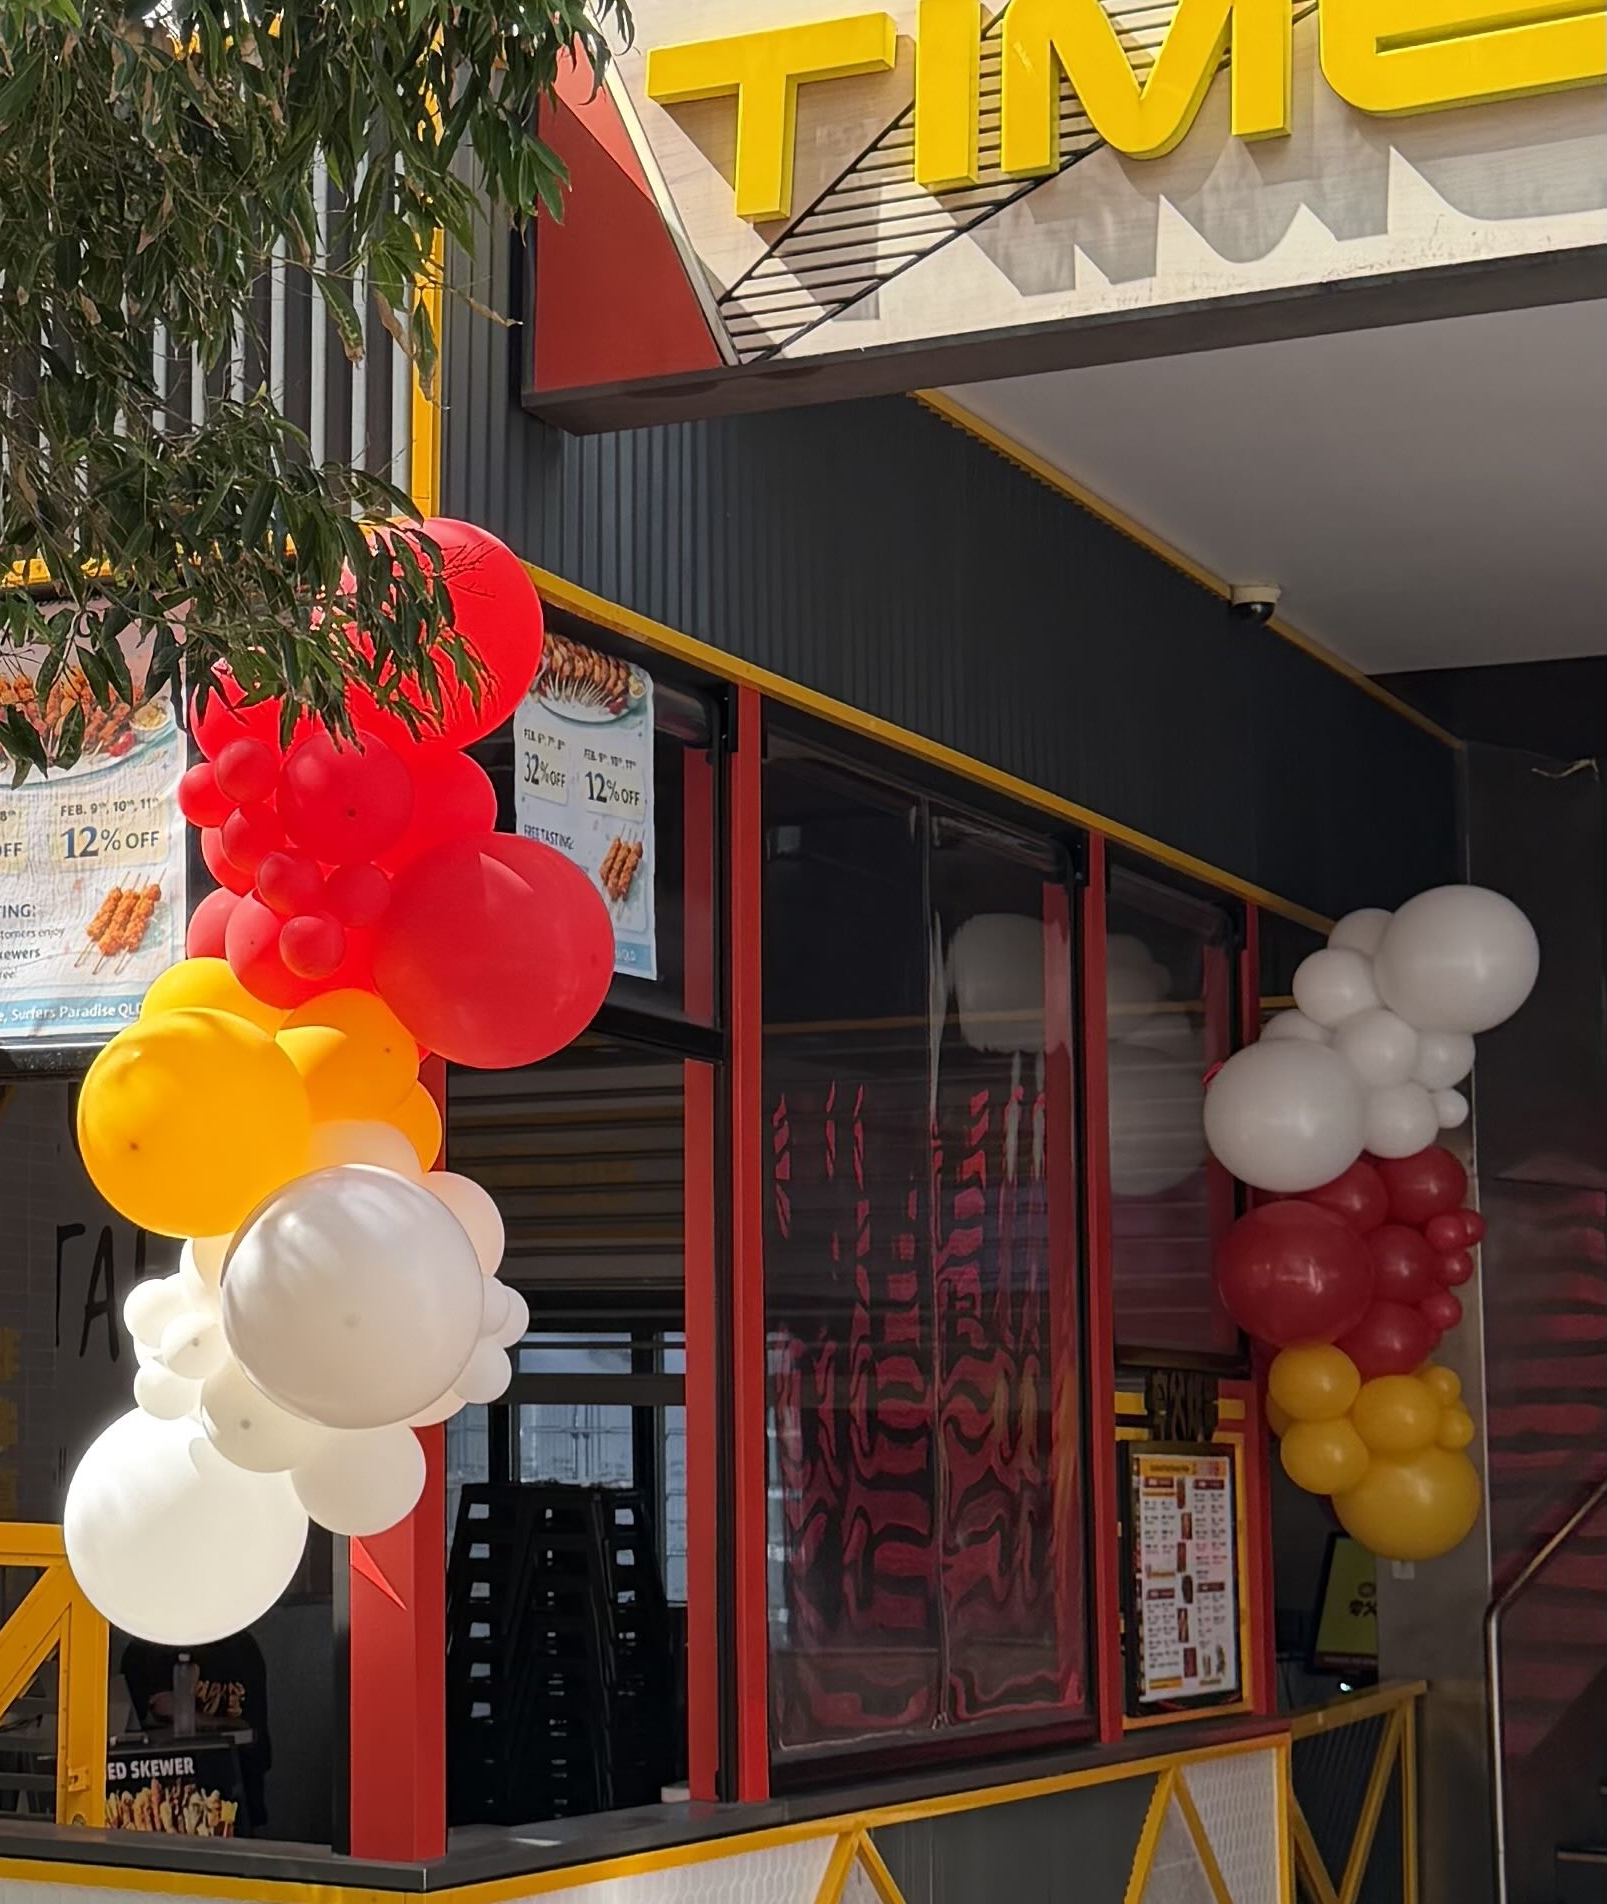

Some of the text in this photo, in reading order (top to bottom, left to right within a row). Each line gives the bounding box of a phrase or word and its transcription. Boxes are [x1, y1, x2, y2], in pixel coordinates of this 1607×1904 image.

[550, 771, 567, 788] OFF
[621, 788, 641, 806] OFF
[60, 804, 87, 817] FEB.
[125, 831, 160, 850] OFF
[37, 927, 65, 940] enjoy
[11, 1005, 56, 1021] Surfers
[59, 1001, 116, 1019] Paradise
[130, 1757, 195, 1779] SKEWER
